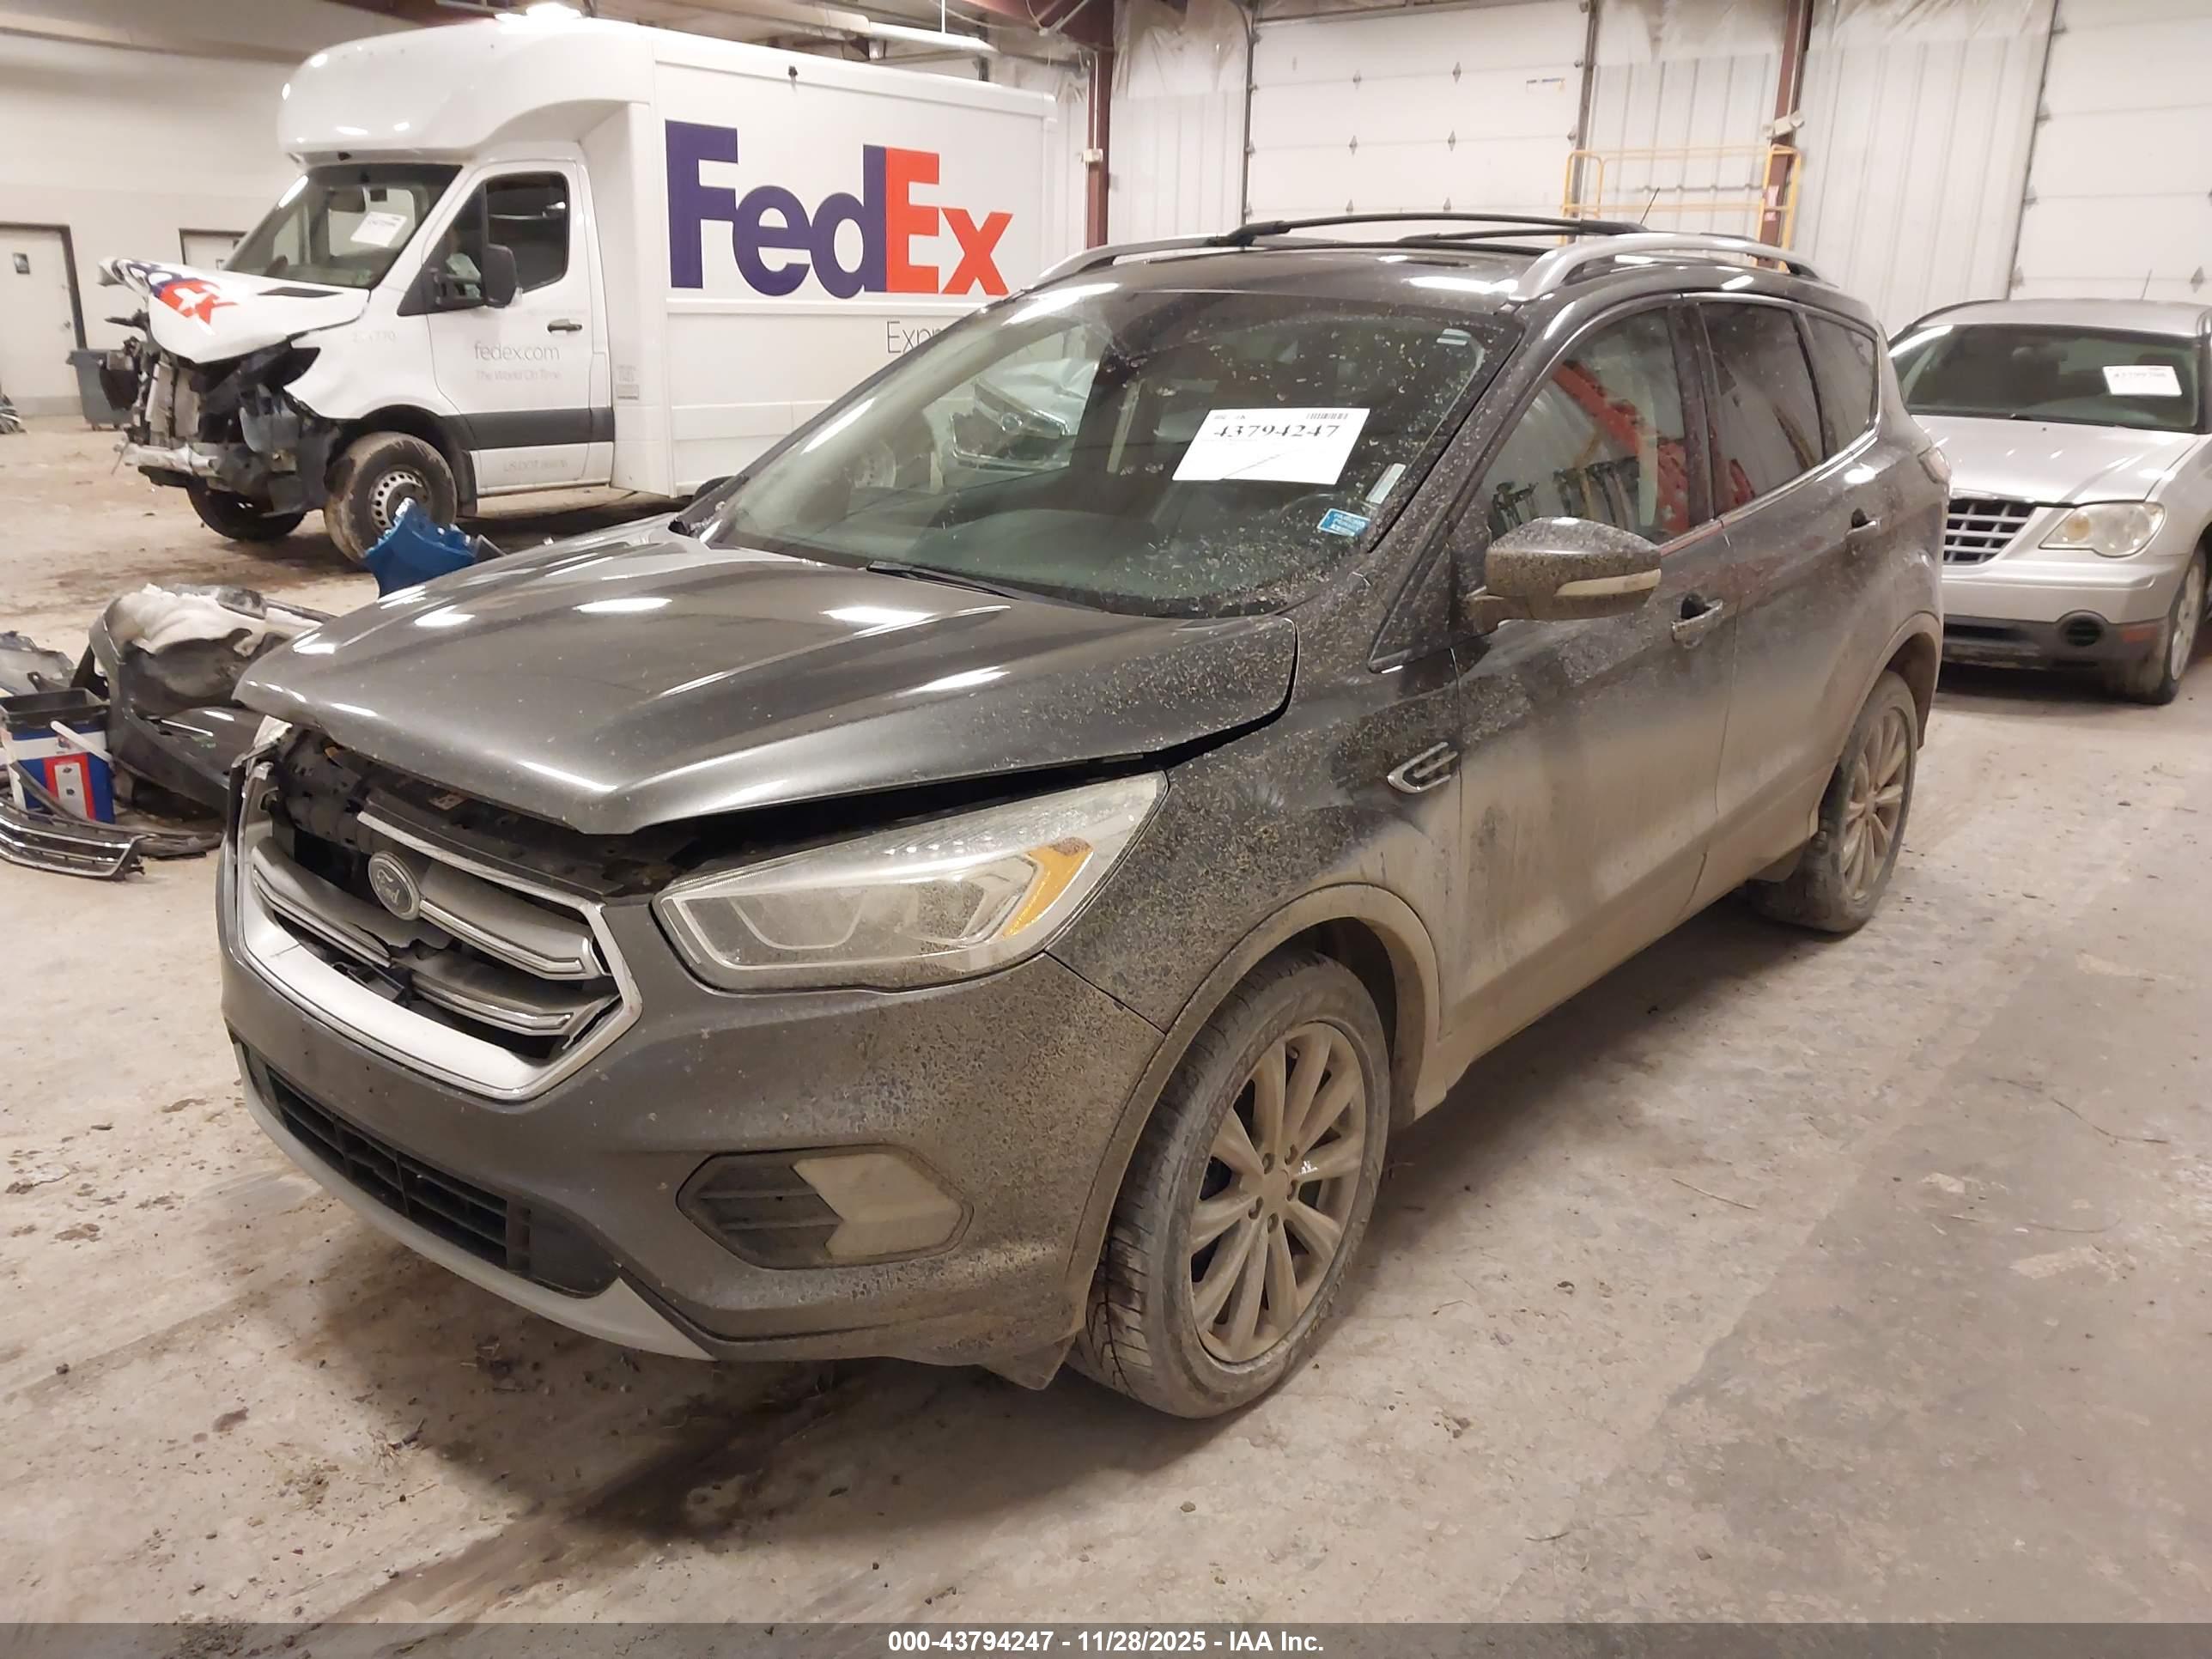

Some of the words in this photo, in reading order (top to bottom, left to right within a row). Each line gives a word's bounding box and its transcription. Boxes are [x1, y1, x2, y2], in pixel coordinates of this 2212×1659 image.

[665, 118, 1013, 299] FedEx
[474, 340, 561, 361] fedex.com
[1213, 424, 1340, 438] 43794247
